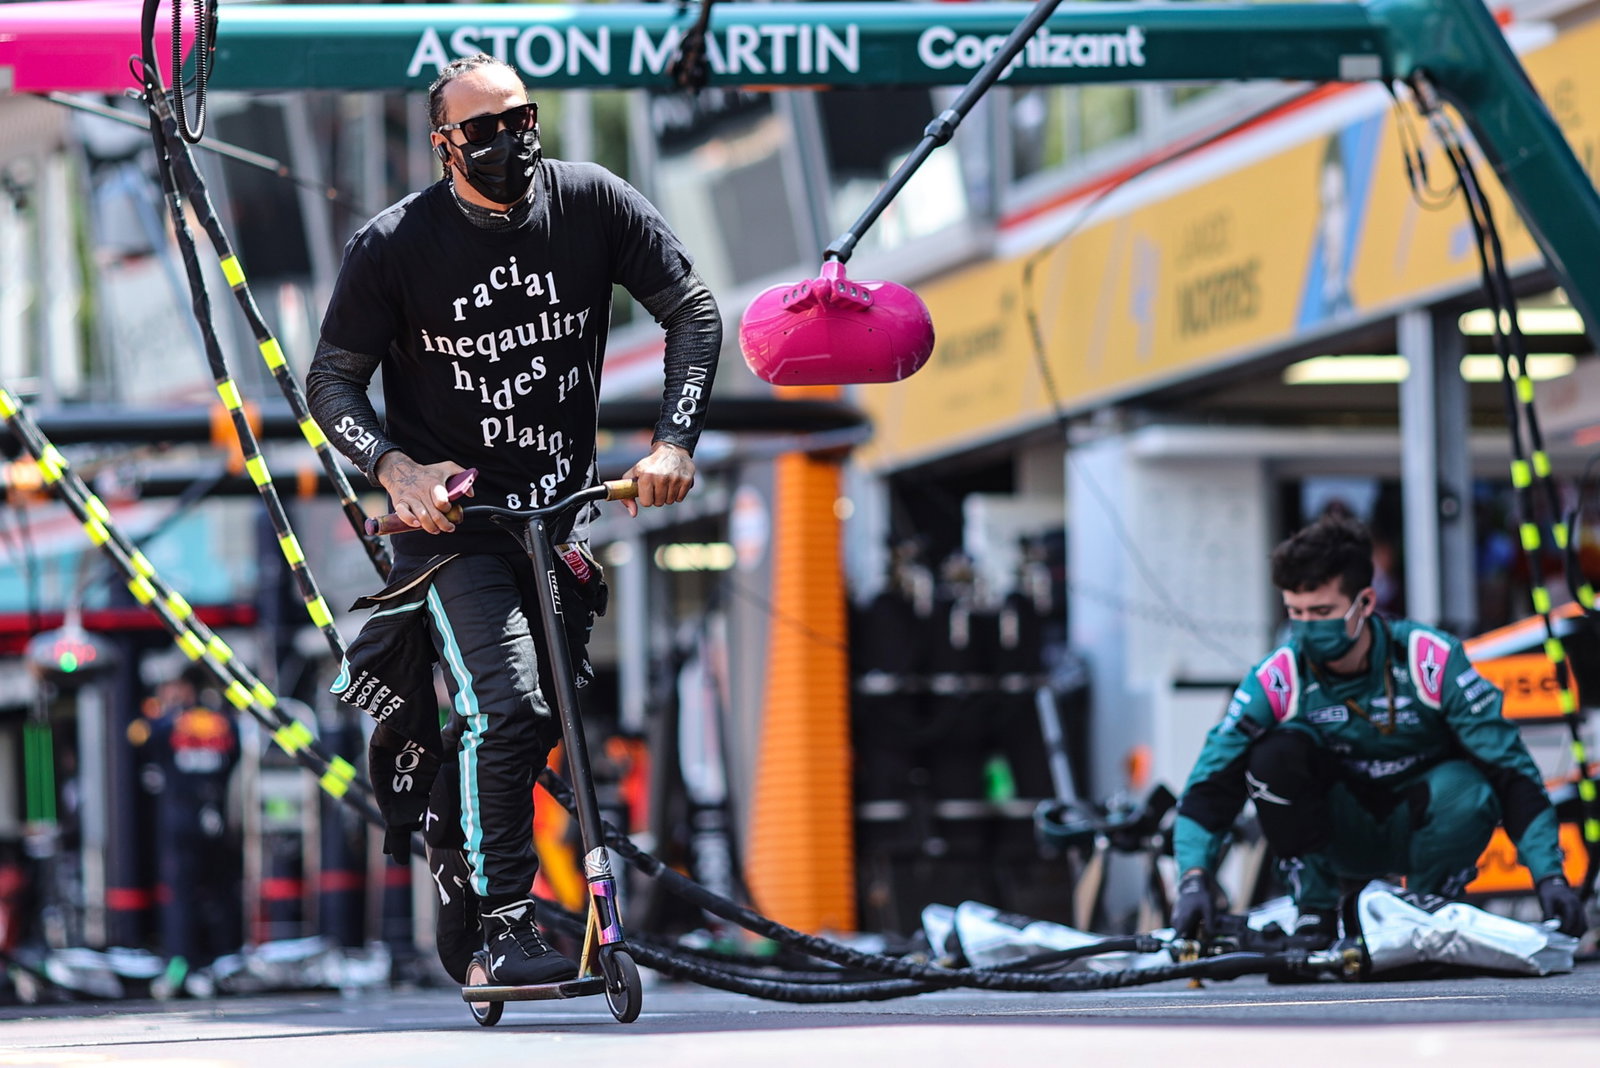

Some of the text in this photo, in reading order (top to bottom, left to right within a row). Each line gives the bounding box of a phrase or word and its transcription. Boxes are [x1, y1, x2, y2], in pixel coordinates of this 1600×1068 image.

[406, 25, 611, 77] ASTON
[452, 255, 561, 322] racial
[421, 306, 592, 363] ineqaulity
[451, 355, 580, 410] hides in
[672, 365, 708, 428] INEOS
[480, 414, 564, 456] plain
[506, 450, 574, 510] sigh
[351, 676, 380, 707] SON
